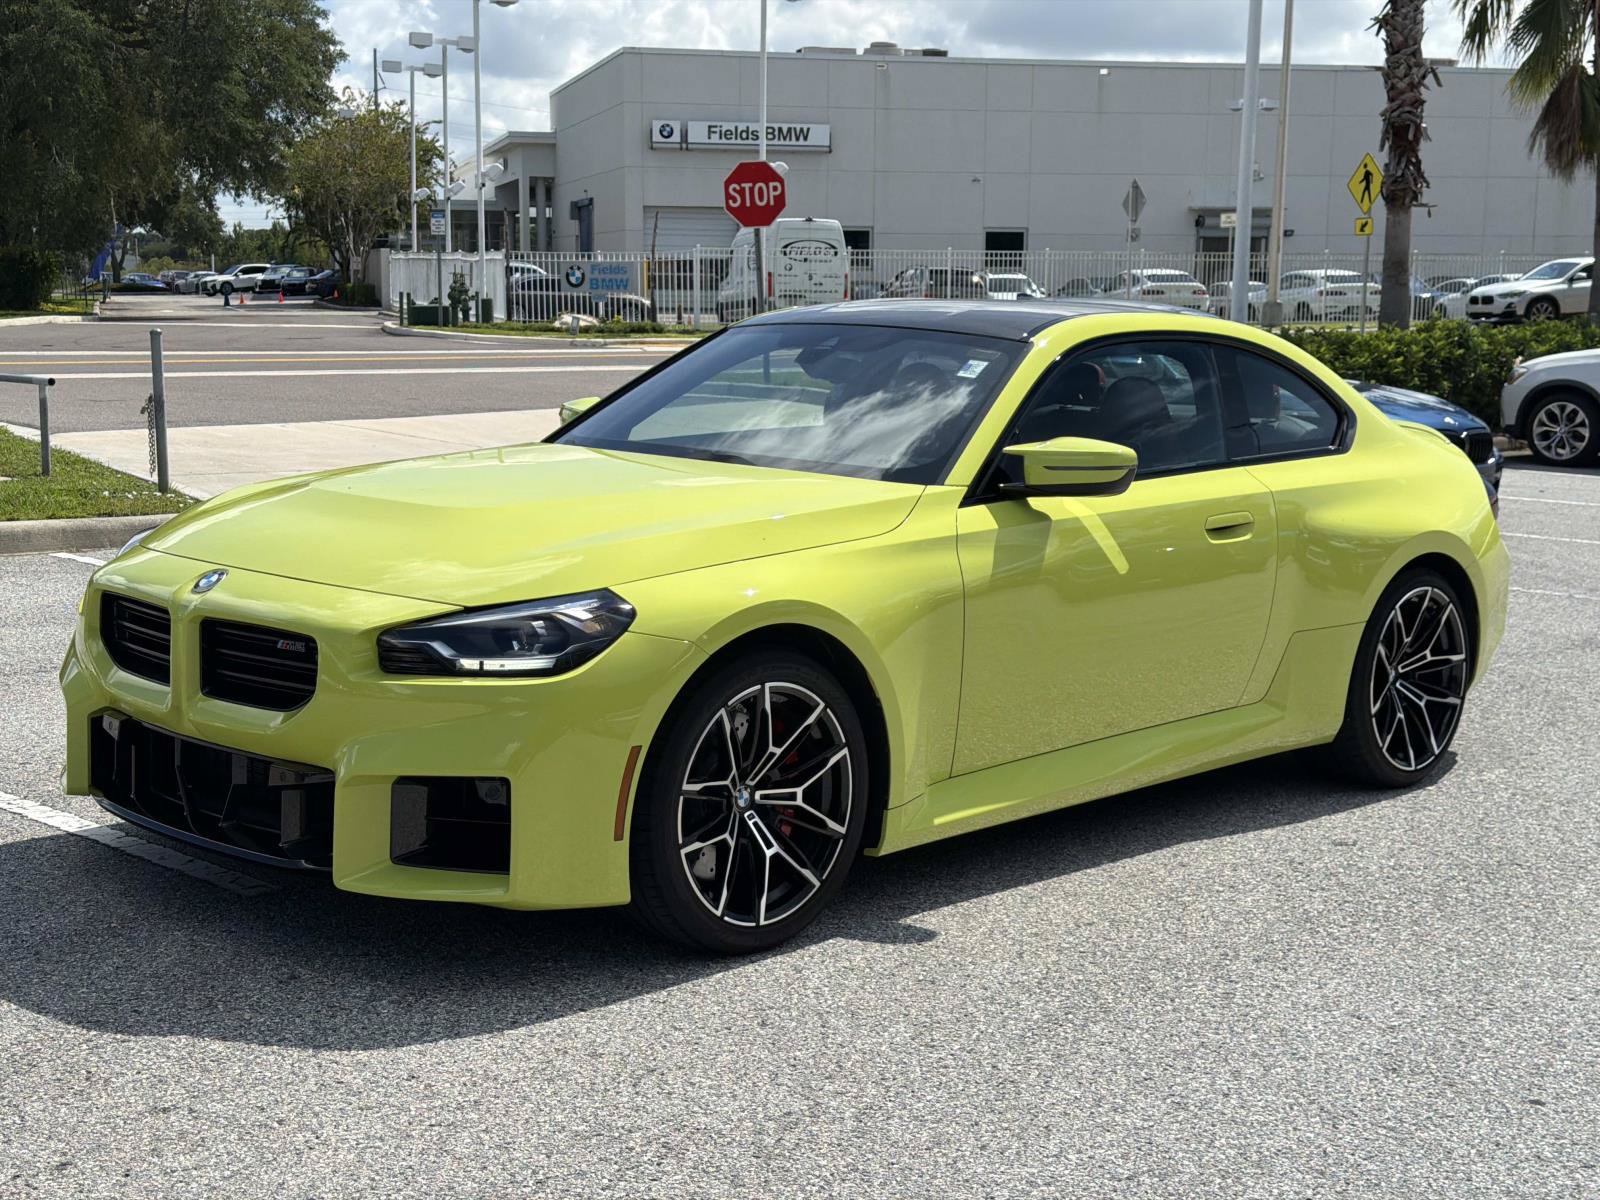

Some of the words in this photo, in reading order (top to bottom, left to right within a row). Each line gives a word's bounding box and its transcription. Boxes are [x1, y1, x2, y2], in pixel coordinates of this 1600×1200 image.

[707, 125, 760, 141] Fields
[765, 127, 811, 142] BMW
[728, 181, 782, 208] STOP
[590, 264, 628, 275] Fields
[589, 277, 630, 290] BMW
